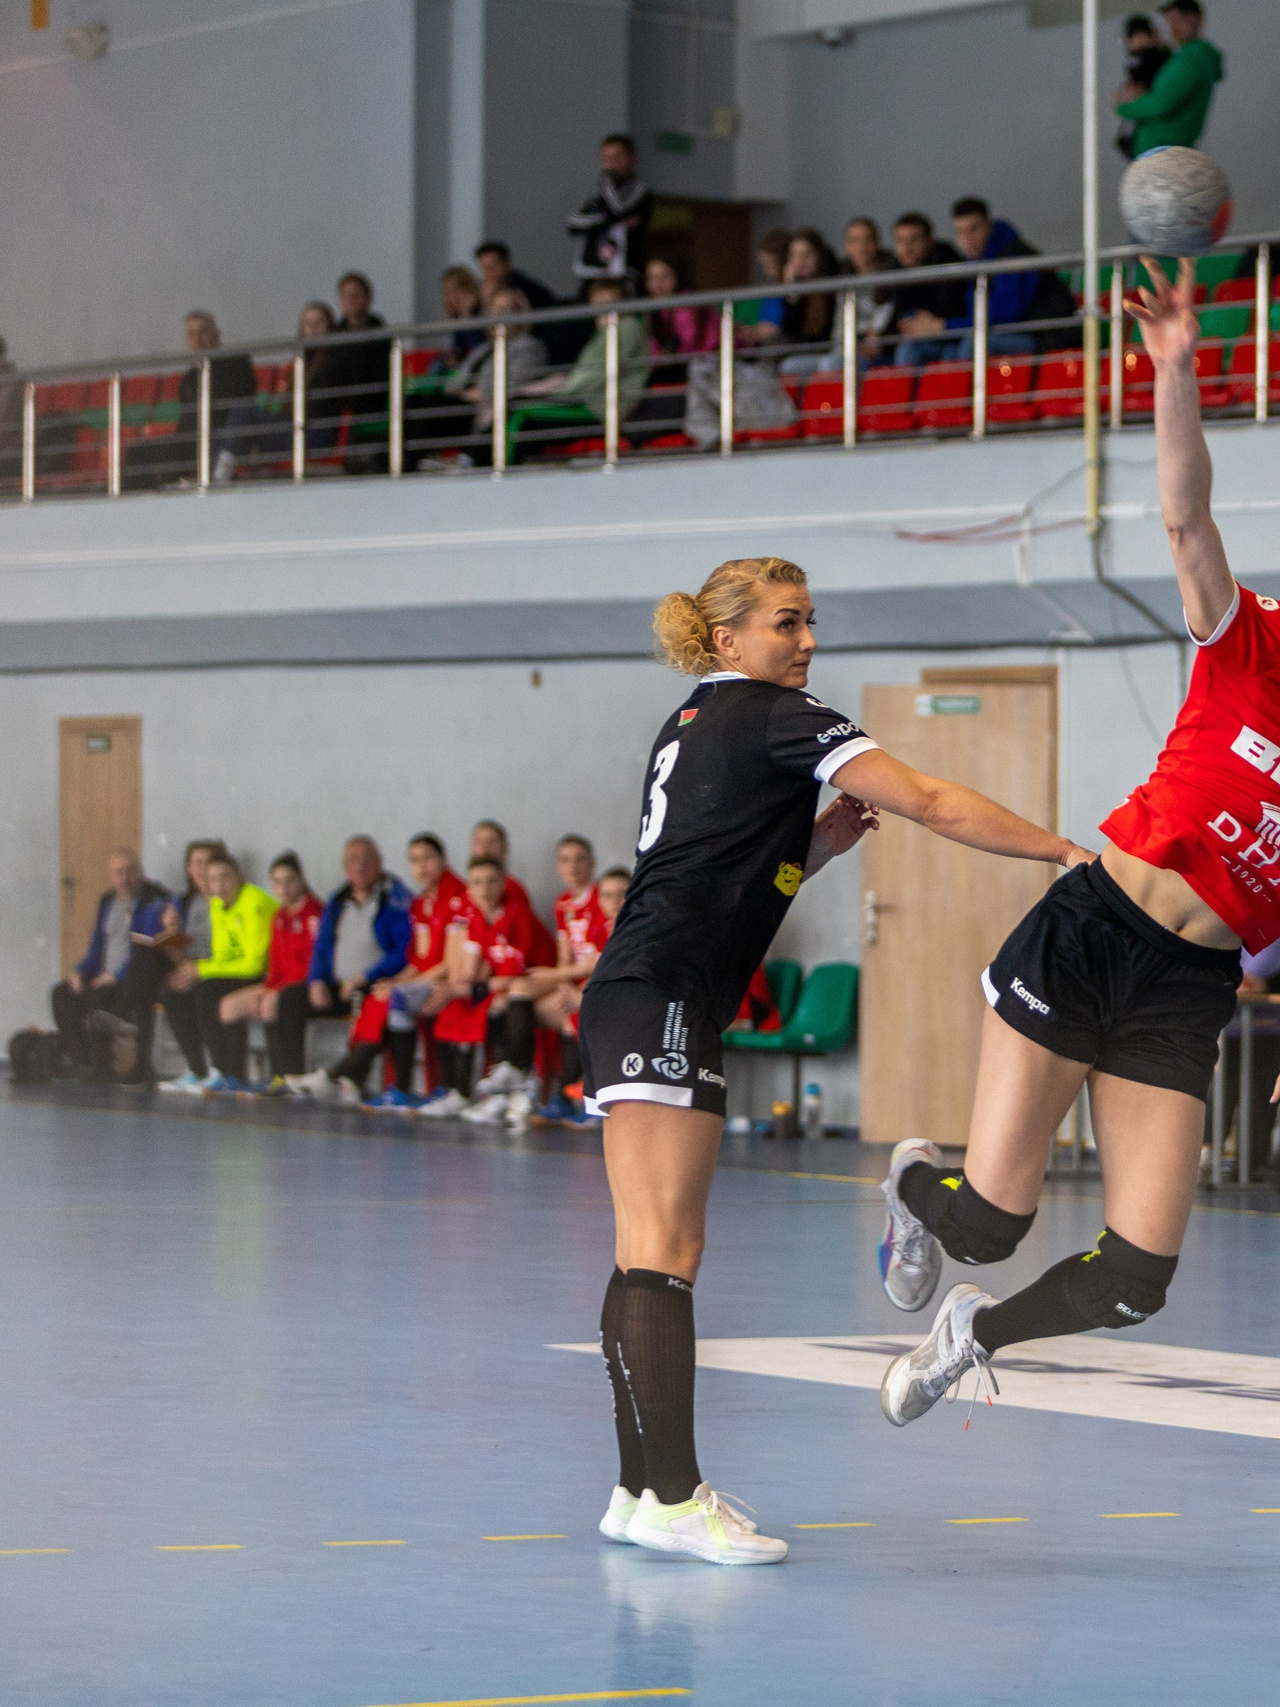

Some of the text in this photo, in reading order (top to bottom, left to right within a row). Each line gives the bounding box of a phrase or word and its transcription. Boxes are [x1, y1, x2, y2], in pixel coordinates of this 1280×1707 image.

[638, 740, 680, 852] 3
[1010, 976, 1050, 1015] Kempa
[679, 1027, 690, 1051] ЗАВОД
